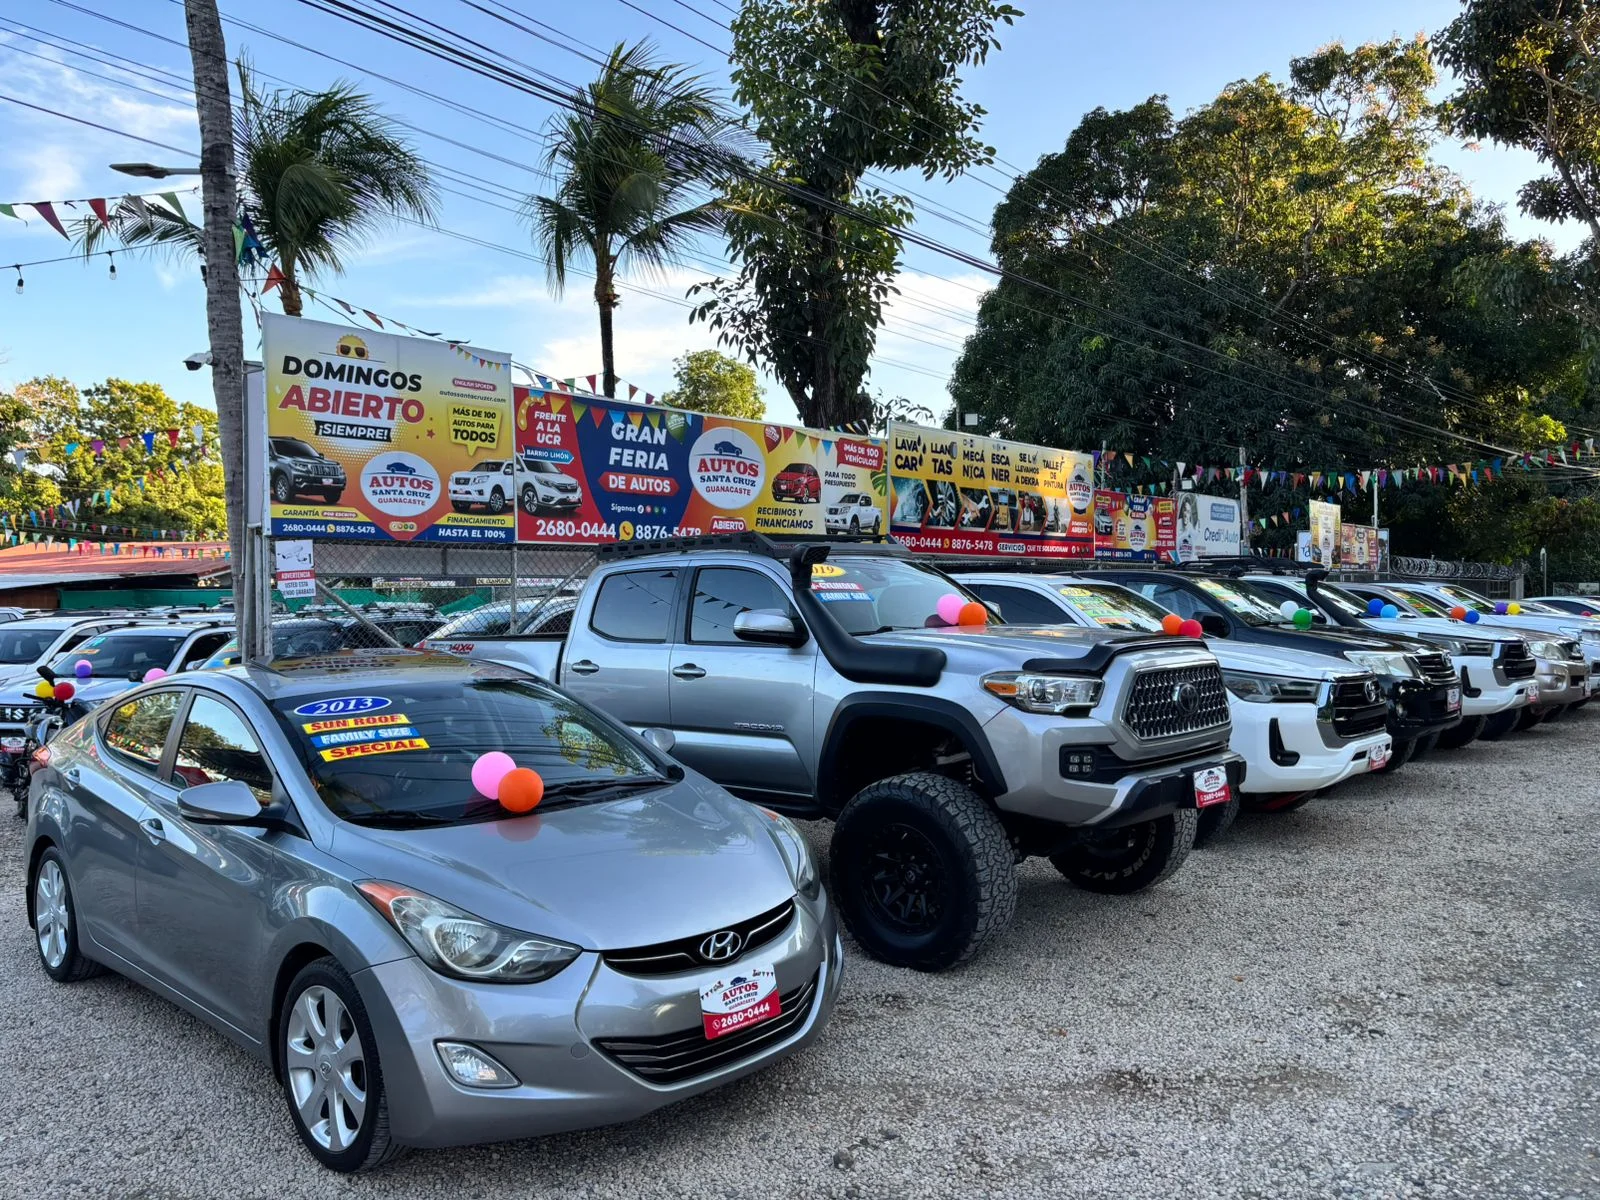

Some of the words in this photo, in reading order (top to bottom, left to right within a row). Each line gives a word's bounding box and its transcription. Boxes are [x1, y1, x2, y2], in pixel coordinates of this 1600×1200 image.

[282, 356, 422, 392] DOMINGOS
[278, 384, 425, 424] ABIERTO
[453, 406, 470, 416] MÁS
[484, 411, 496, 419] 100
[534, 411, 567, 422] FRENTE
[318, 422, 388, 440] ¡SIEMPRE!
[536, 421, 544, 431] A
[547, 422, 560, 433] LA
[453, 429, 496, 443] TODOS
[537, 433, 561, 445] UCR
[611, 422, 667, 446] GRAN
[895, 437, 918, 452] LAVA
[527, 449, 548, 457] BARRIO
[550, 452, 569, 460] LIMÓN
[609, 446, 669, 471] FERIA
[867, 448, 879, 458] 100
[963, 450, 985, 463] MECÁ
[992, 453, 1010, 466] ESCA
[1019, 453, 1026, 462] SE
[844, 453, 878, 467] VEHÍCULOS!
[895, 454, 918, 472] CAR
[932, 458, 953, 475] TAS
[697, 457, 759, 477] AUTOS
[1015, 465, 1039, 474] LLEVAMOS
[700, 474, 731, 483] SANTA
[733, 476, 756, 487] CRUZ
[992, 467, 1010, 482] NER
[1015, 476, 1019, 484] A
[1021, 476, 1039, 486] DEKRA
[1050, 472, 1056, 480] DE
[370, 476, 434, 491] AUTOS
[609, 474, 626, 489] DE
[630, 477, 671, 493] AUTOS
[1044, 480, 1063, 490] PINTURA
[1069, 483, 1090, 493] AUTOS
[406, 490, 431, 499] CRUZ
[706, 486, 751, 496] GUANACASTE
[378, 498, 426, 506] GUANACASTE
[611, 503, 636, 513] Síganos
[282, 508, 320, 517] GARANTÍA
[757, 507, 796, 516] RECIBIMOS
[447, 516, 506, 525] FINANCIAMIENTO
[713, 520, 744, 530] ABIERTO
[756, 518, 813, 529] FINANCIAMOS
[282, 524, 325, 532] 2680-0444
[336, 525, 376, 534] 8876-5478
[438, 528, 469, 537] HASTA
[472, 529, 481, 538] EL
[484, 530, 506, 539] 100%
[536, 520, 616, 538] 2680-0444
[951, 539, 993, 550] 8876-5478
[812, 566, 834, 574] 019
[314, 698, 373, 715] 2013
[312, 719, 349, 731] SUN
[354, 715, 401, 726] ROOF
[734, 722, 784, 731] TACOMA
[320, 729, 376, 745] FAMILY
[379, 727, 412, 738] SIZE
[330, 740, 421, 758] SPECIAL
[722, 982, 758, 1002] AUTOS
[724, 996, 744, 1006] SANTA
[744, 991, 758, 1000] CRUZ
[721, 1002, 770, 1028] 2680-0444
